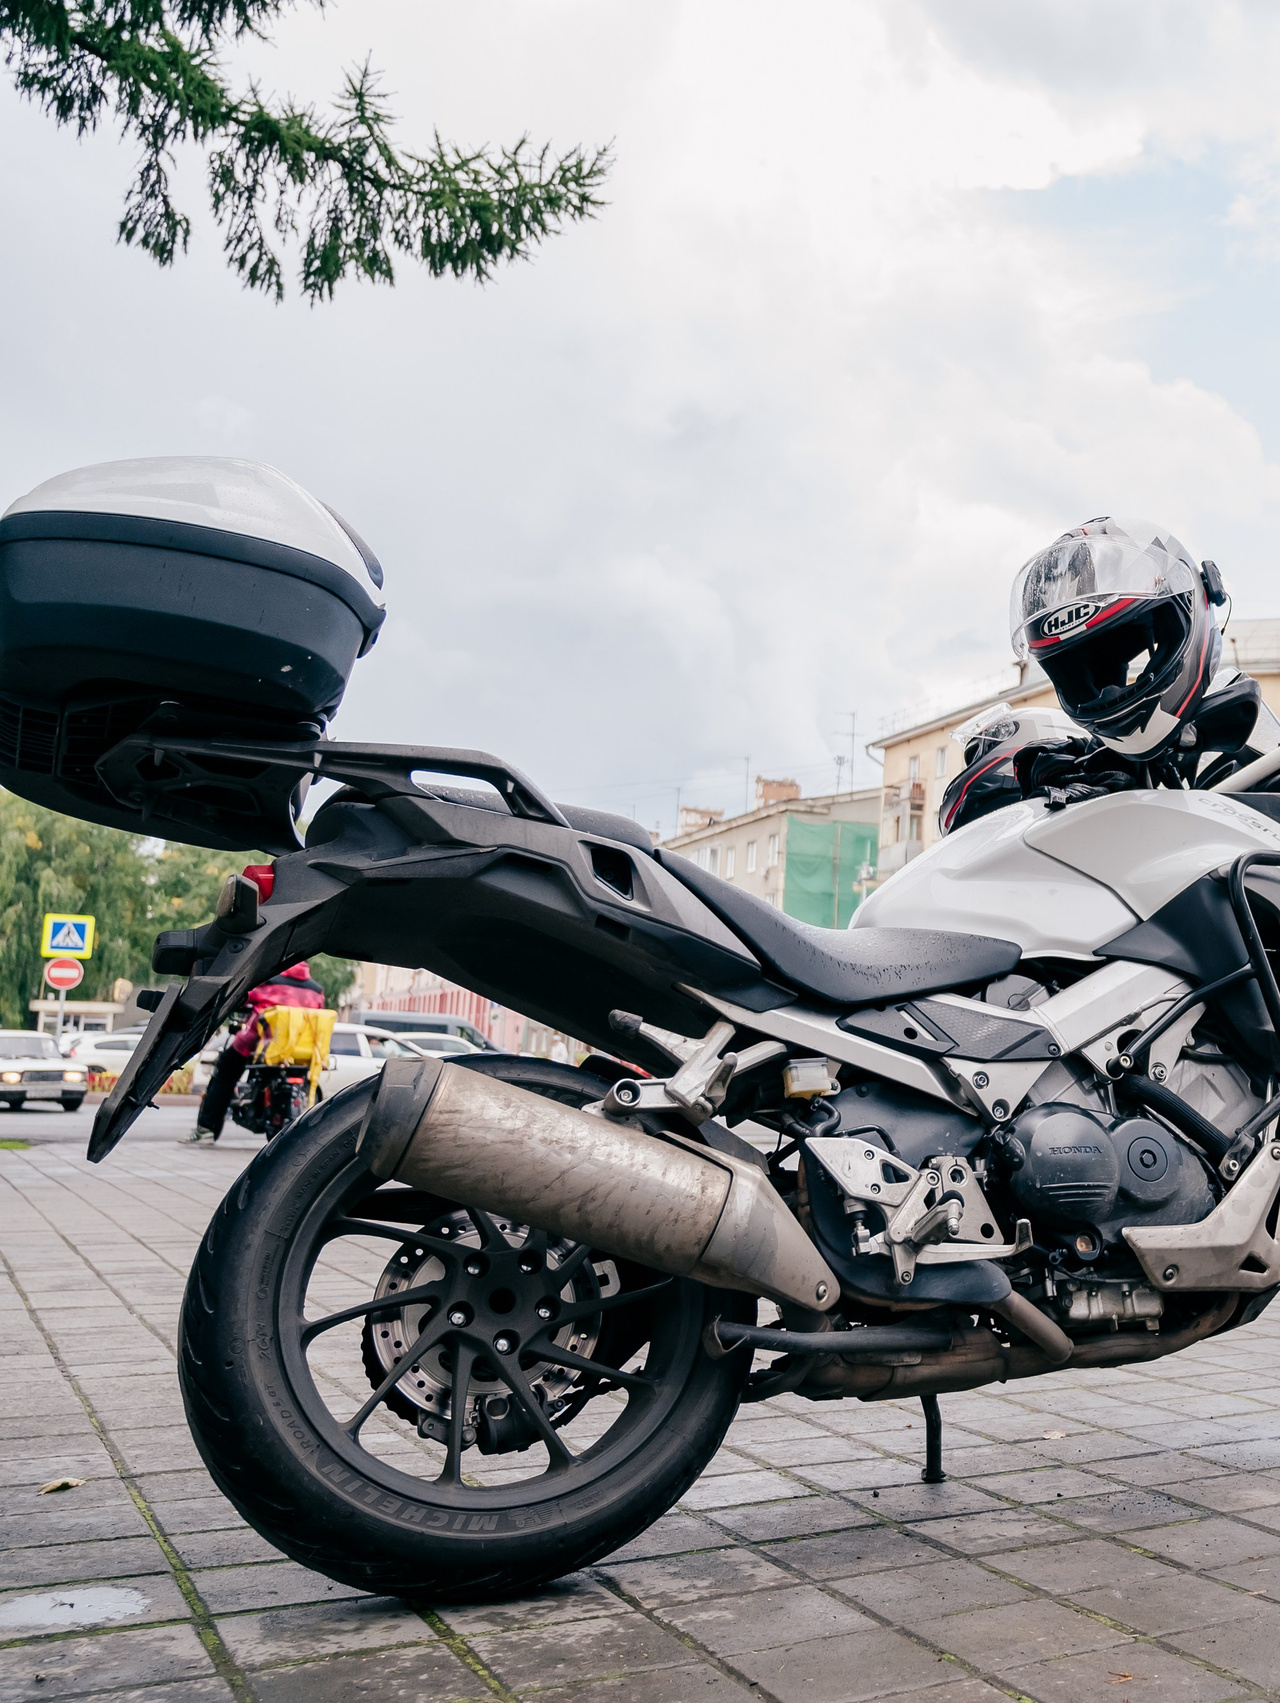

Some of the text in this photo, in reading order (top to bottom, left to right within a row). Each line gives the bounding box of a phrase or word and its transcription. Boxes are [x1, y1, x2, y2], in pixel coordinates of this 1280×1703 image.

[1047, 604, 1090, 634] HJC
[1048, 1145, 1103, 1156] HONDA
[279, 1407, 317, 1449] ROAD
[321, 1463, 501, 1531] MICHELIN
